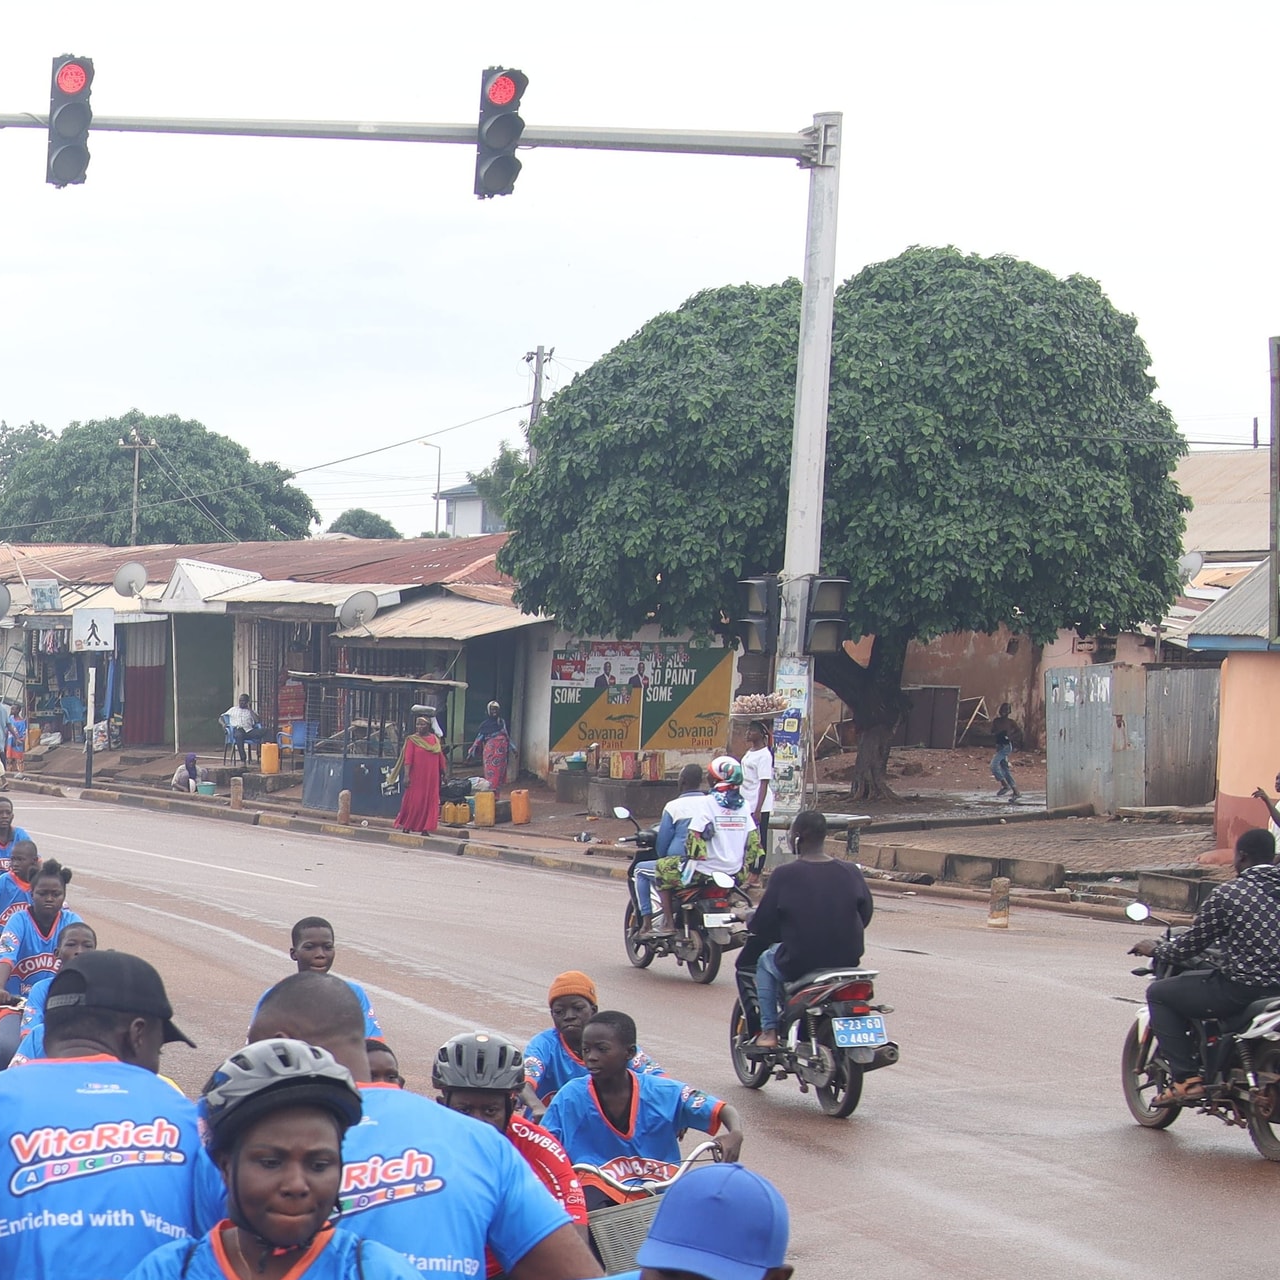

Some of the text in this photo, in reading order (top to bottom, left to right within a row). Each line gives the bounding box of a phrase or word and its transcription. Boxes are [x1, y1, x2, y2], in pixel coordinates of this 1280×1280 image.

[665, 669, 697, 685] PAINT
[554, 688, 581, 704] SOME
[646, 687, 672, 702] SOME
[578, 722, 625, 741] Savana
[668, 720, 714, 738] Savana
[601, 740, 623, 749] Paint
[691, 738, 713, 746] Paint
[850, 1033, 875, 1043] 4494
[11, 1117, 180, 1164] VitaRich
[511, 1122, 568, 1164] COWBELL
[27, 1152, 172, 1183] A B9 C D E K
[341, 1149, 433, 1191] Rich
[358, 1183, 425, 1207] D E K
[89, 1209, 134, 1227] with
